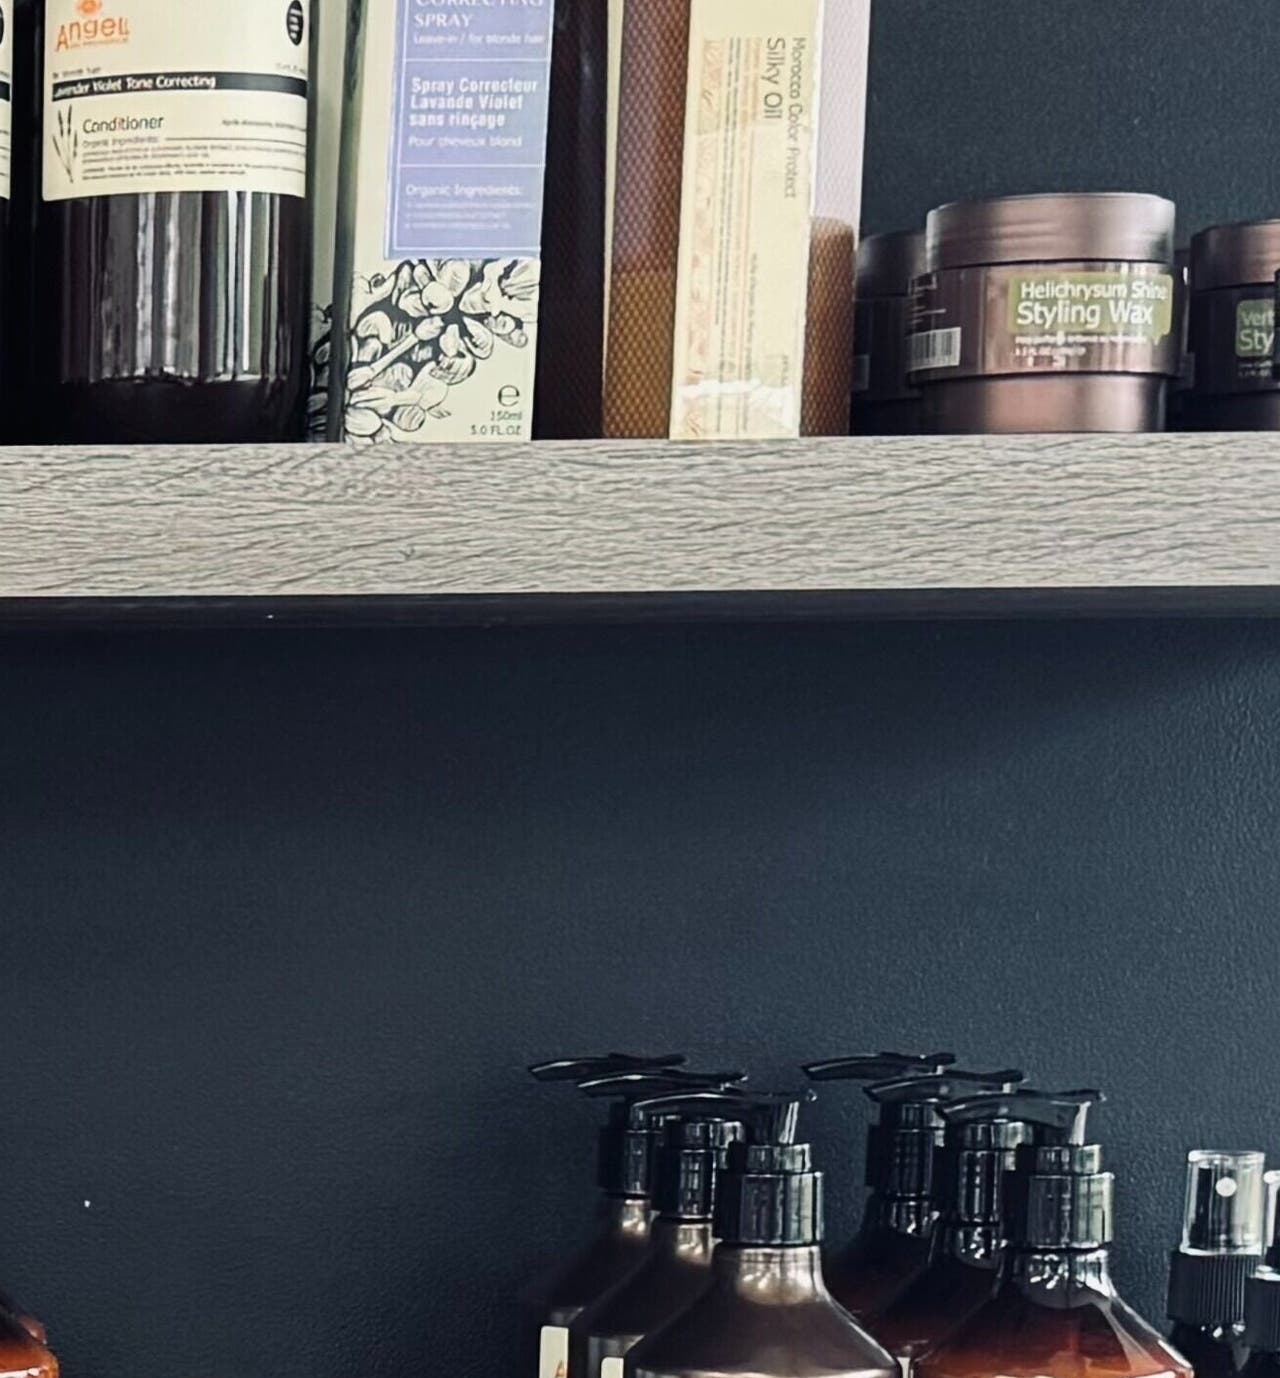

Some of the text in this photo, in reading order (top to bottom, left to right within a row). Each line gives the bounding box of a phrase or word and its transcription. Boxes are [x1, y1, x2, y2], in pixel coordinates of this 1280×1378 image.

[414, 13, 473, 28] SPRAY
[468, 34, 483, 44] for
[485, 34, 522, 44] blonde
[524, 34, 544, 44] hair
[788, 37, 807, 100] Morocco
[92, 75, 216, 93] Violet Tone Correcting
[412, 77, 538, 95] Spray Correcteur
[761, 37, 787, 119] Silky Oil
[410, 95, 524, 110] Lavande Violet
[82, 115, 165, 134] Conditioner
[409, 113, 506, 130] sans rinçage
[787, 102, 803, 144] Color
[408, 136, 434, 148] Pour
[439, 137, 486, 147] cheveux
[406, 184, 451, 200] Organic
[1020, 280, 1168, 302] Helichrysum Shine
[1016, 301, 1154, 329] Styling Wax
[490, 410, 522, 421] 150ml
